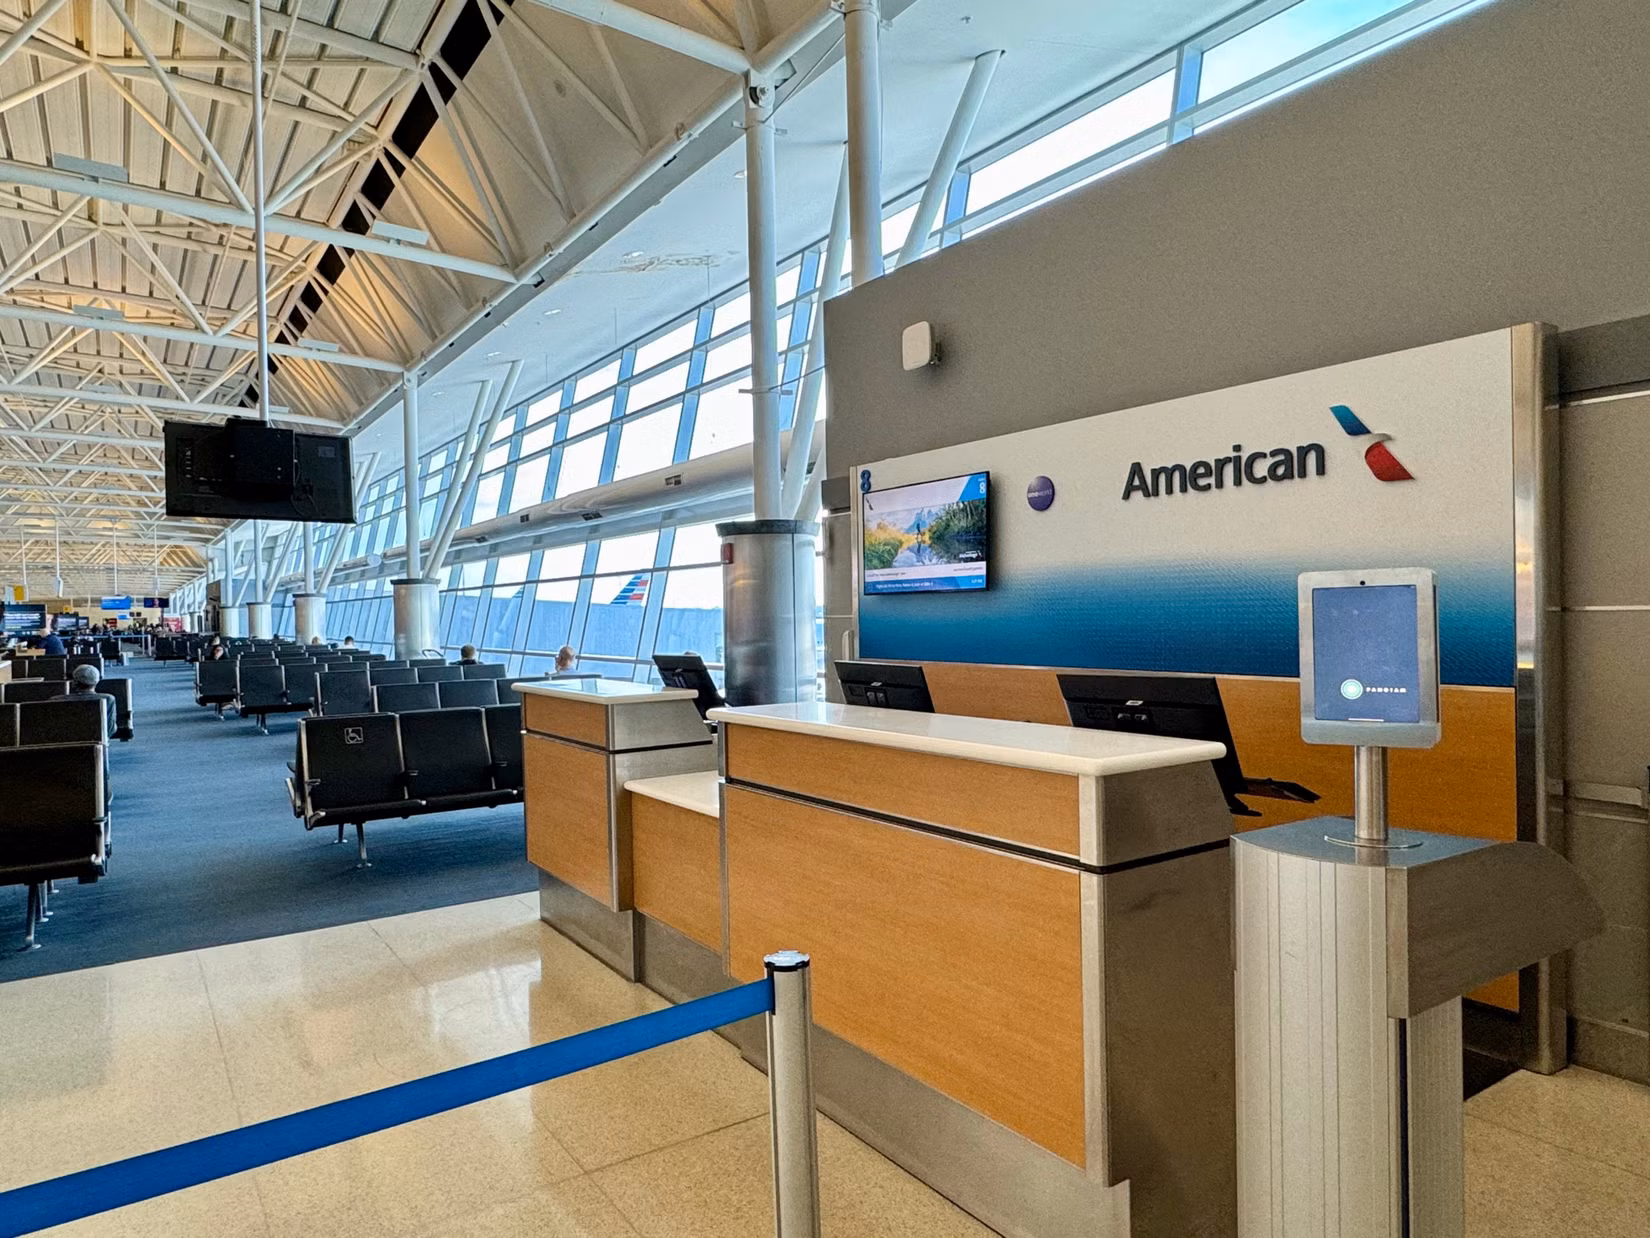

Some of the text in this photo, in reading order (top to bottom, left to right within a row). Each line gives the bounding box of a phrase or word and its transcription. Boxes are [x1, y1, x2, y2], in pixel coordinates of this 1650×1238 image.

[860, 469, 871, 492] 8
[1122, 442, 1326, 500] American
[979, 482, 986, 494] 8
